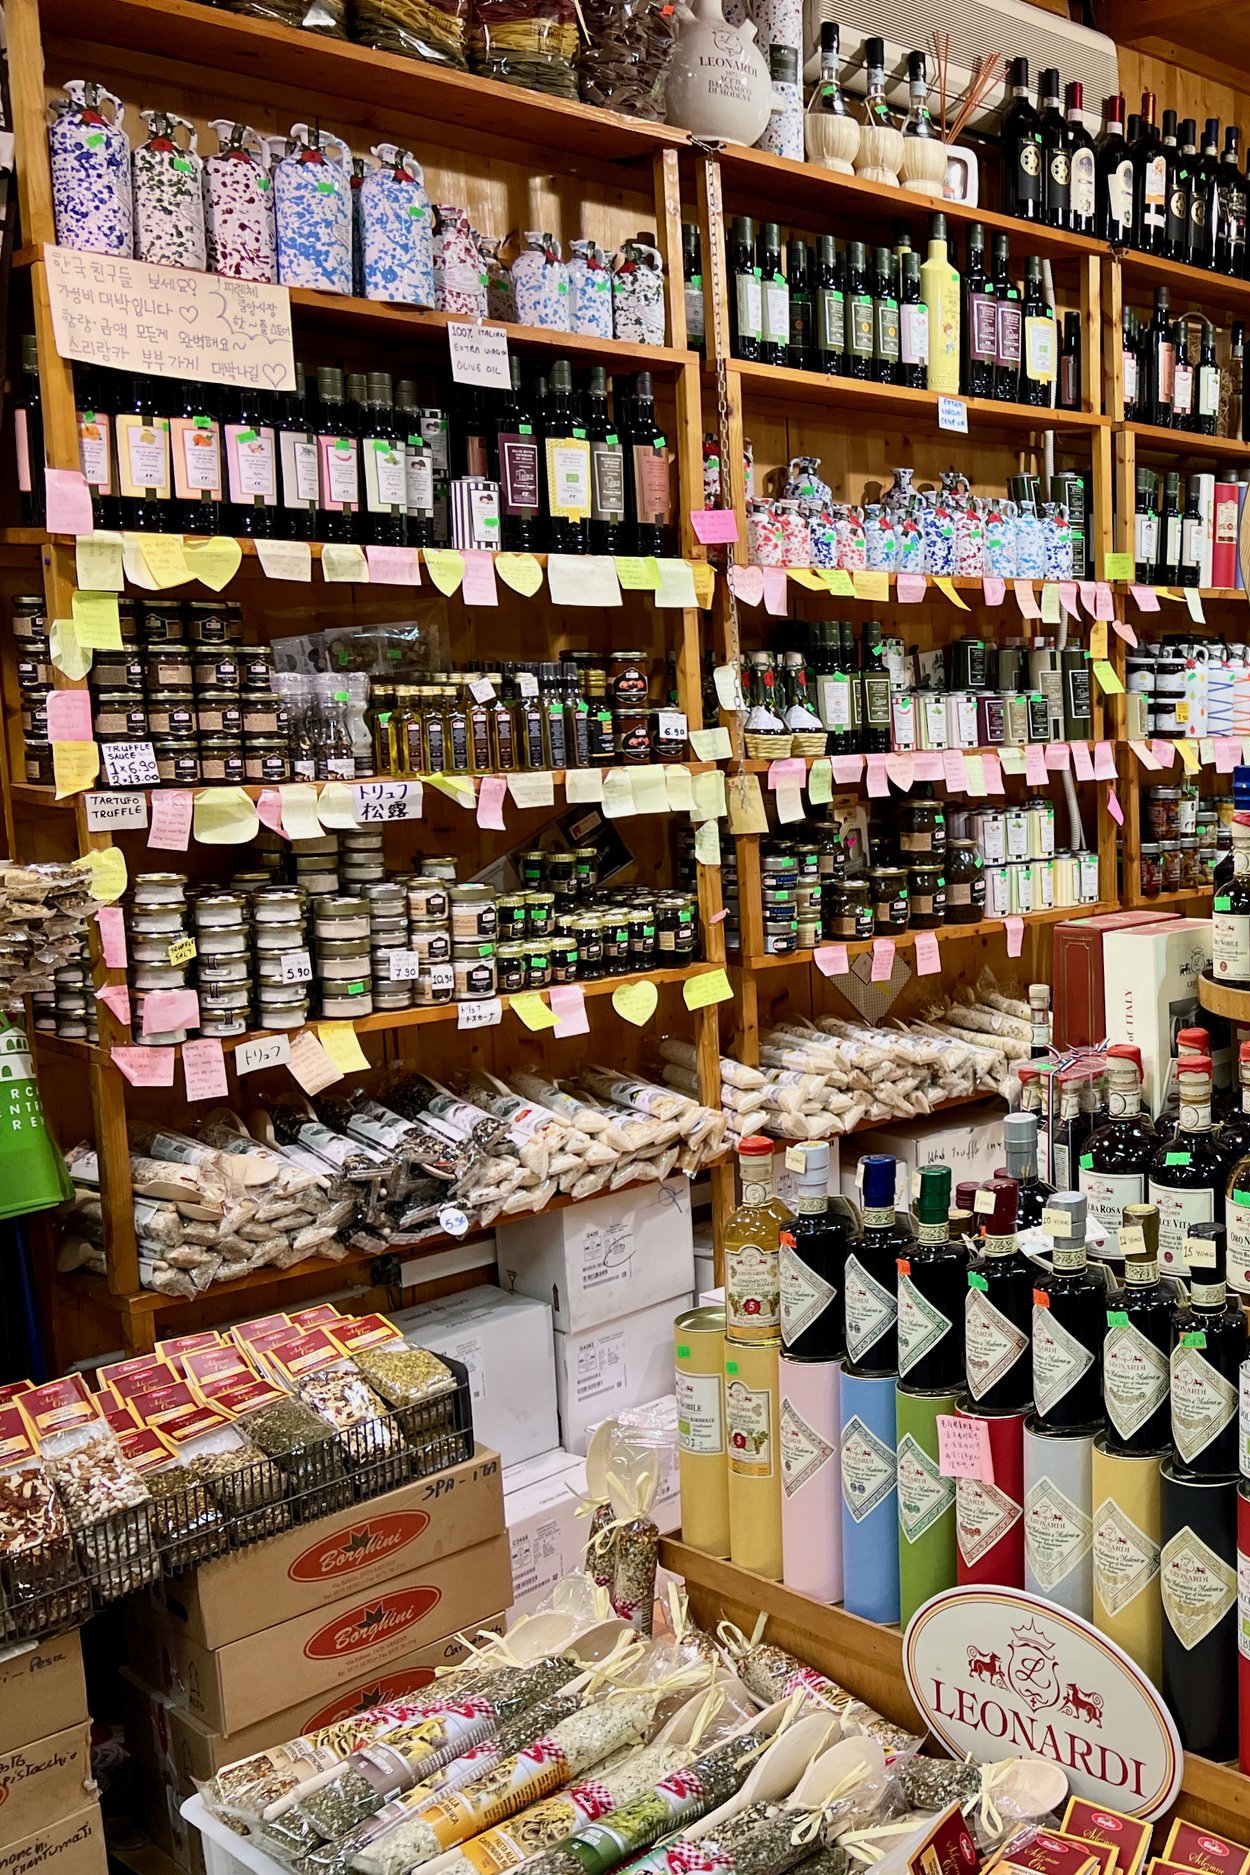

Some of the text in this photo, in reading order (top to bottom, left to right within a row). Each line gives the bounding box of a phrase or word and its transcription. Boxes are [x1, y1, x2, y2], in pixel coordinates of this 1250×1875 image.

[699, 56, 758, 78] LEONARDI
[454, 343, 480, 354] EXTRA
[457, 361, 501, 375] OLIVE OIL
[664, 727, 685, 736] 6.90
[105, 744, 150, 753] TRUFFLE
[107, 752, 137, 760] SAUCE
[128, 760, 157, 775] 6.90
[360, 784, 408, 800] トリュフ
[90, 796, 140, 806] TARTUFO
[91, 805, 142, 819] TRUFFLE
[361, 800, 410, 820] 松露
[286, 967, 310, 980] 5.90
[1124, 988, 1134, 1025] ITALY
[244, 1045, 281, 1066] トリュフ
[1100, 1204, 1121, 1214] ROSA
[748, 1302, 756, 1312] 5
[319, 1527, 404, 1573] Borghini
[333, 1603, 416, 1651] Borghini
[930, 1677, 1148, 1799] LEONARDI
